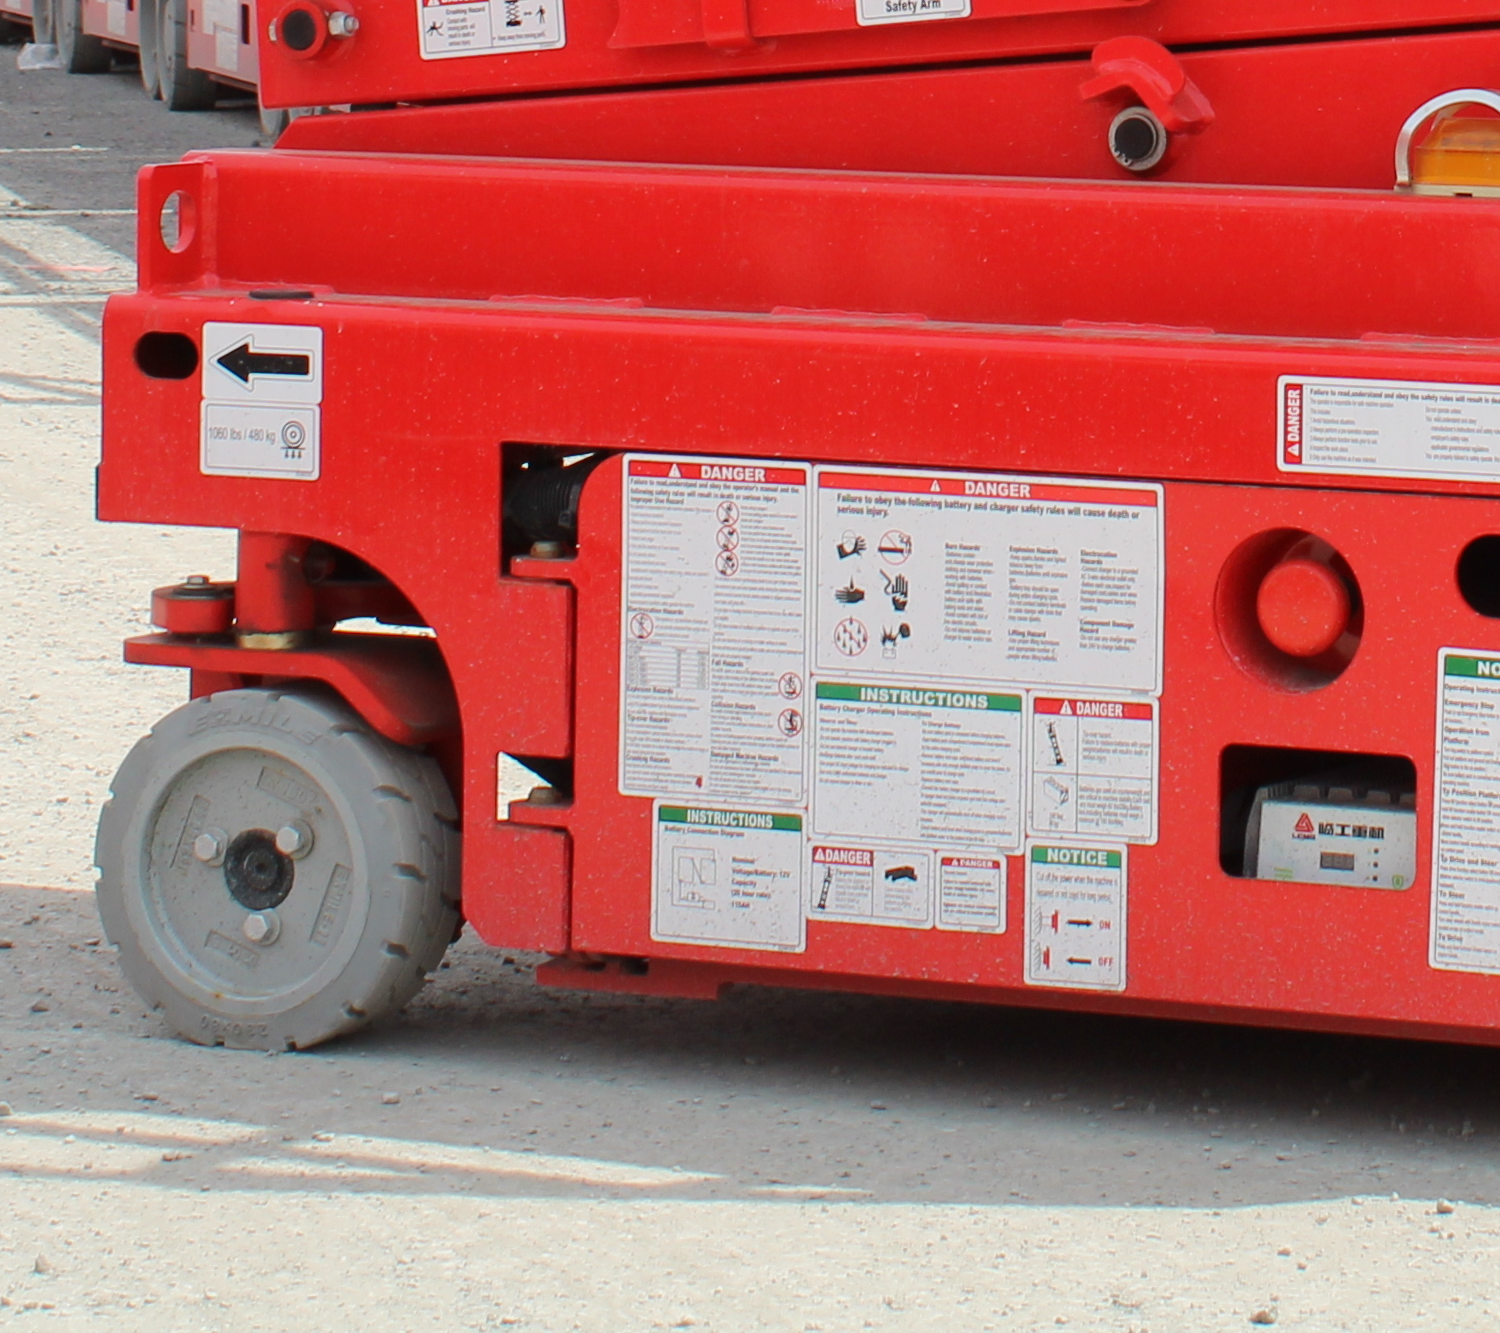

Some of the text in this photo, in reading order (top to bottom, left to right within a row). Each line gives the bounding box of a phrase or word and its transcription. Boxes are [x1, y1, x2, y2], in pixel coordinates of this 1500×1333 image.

[886, 0, 917, 14] Safety
[1310, 388, 1332, 396] Failure
[1396, 392, 1409, 402] obey
[1411, 392, 1419, 400] the
[1421, 393, 1438, 403] safety
[1439, 394, 1453, 402] rules
[1467, 395, 1482, 403] result
[1288, 389, 1301, 442] DANGER
[209, 427, 227, 440] 1060
[230, 428, 242, 441] lbs
[250, 429, 264, 441] 480
[266, 430, 276, 445] kg
[701, 465, 766, 482] DANGER
[965, 481, 1030, 498] DANGER
[837, 493, 1139, 520] Failure to obey the following battery and charger safety rules will cause death or
[837, 506, 888, 518] serious injury.
[1444, 684, 1474, 694] Operating
[860, 686, 988, 709] INSTRUCTIONS
[820, 703, 841, 713] Battery
[843, 705, 865, 715] Charger
[867, 706, 895, 717] Operating
[1077, 702, 1123, 717] DANGER
[1480, 701, 1494, 710] Stop
[687, 809, 773, 828] INSTRUCTIONS
[664, 825, 685, 835] Battery
[720, 829, 745, 838] Diagram
[826, 848, 871, 865] DANGER
[960, 858, 993, 868] DANGER
[1047, 848, 1108, 865] NOTICE
[1099, 920, 1111, 930] ON
[1099, 957, 1114, 967] OFF
